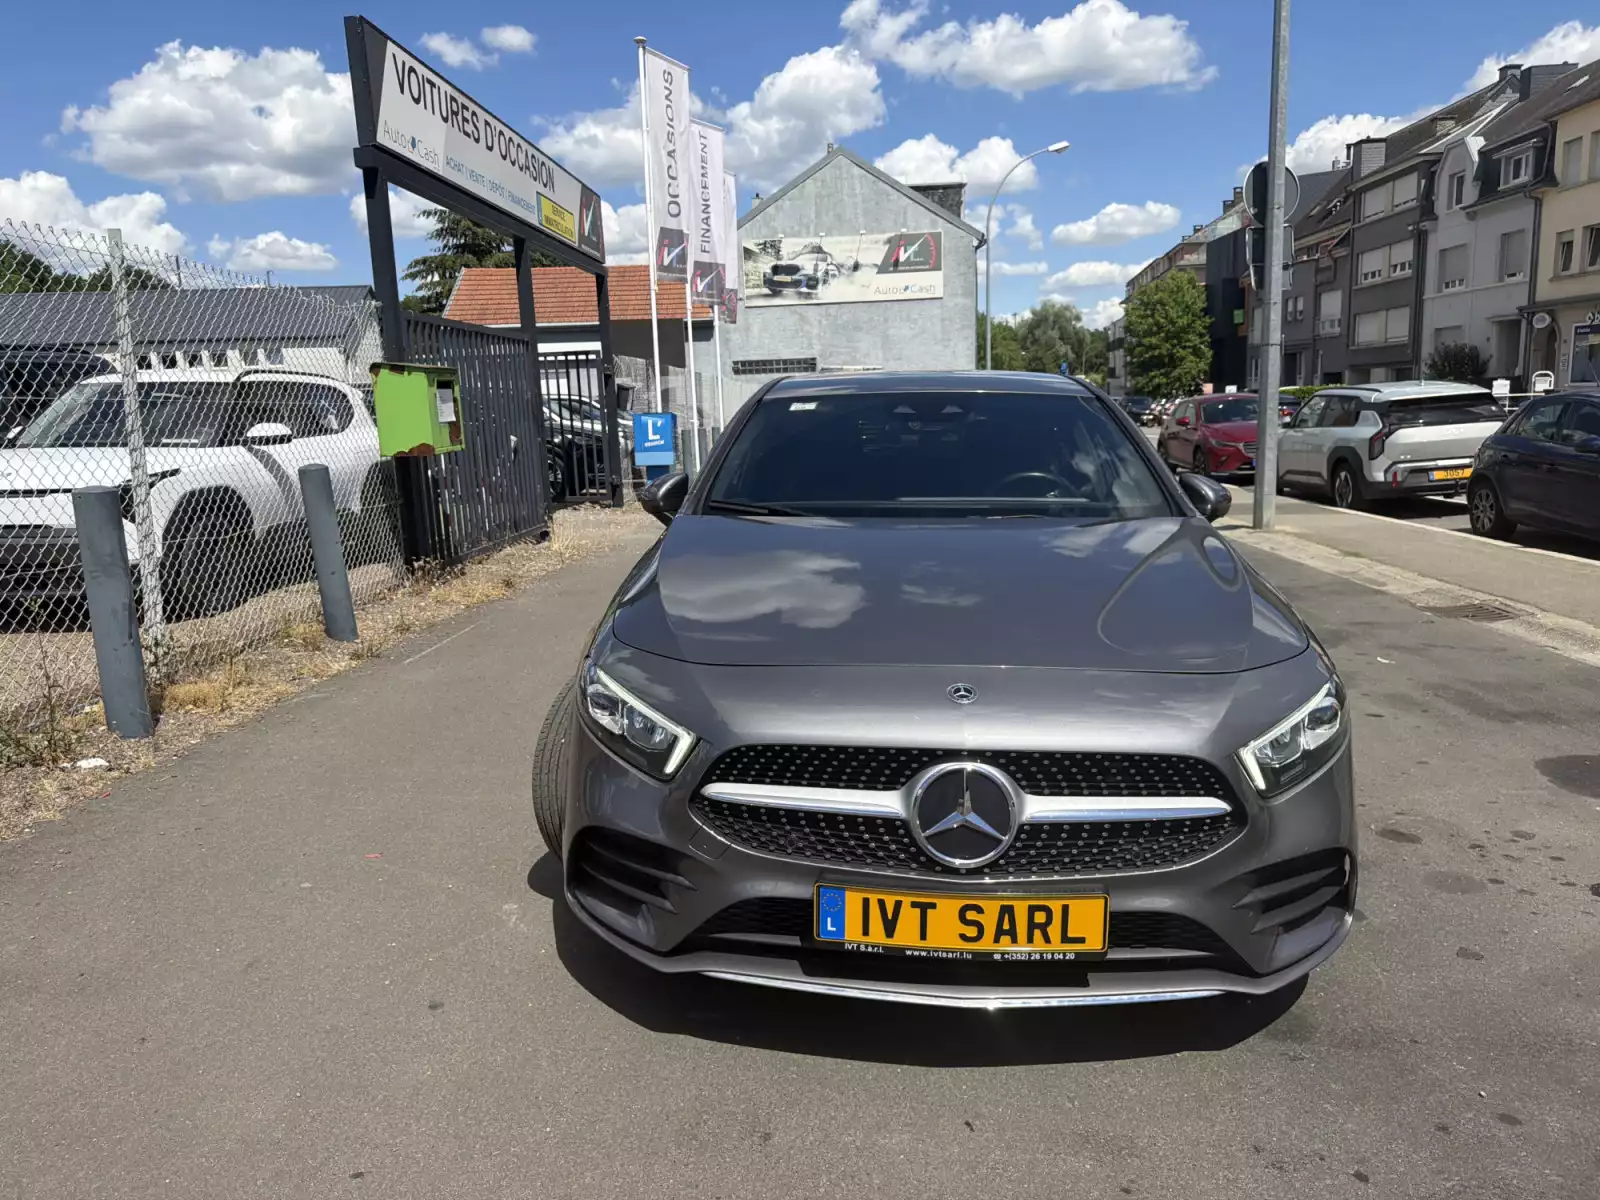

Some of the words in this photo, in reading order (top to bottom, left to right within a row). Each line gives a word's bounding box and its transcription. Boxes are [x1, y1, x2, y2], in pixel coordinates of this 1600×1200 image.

[392, 52, 480, 144] VOITURES
[484, 118, 555, 193] D'OCCASION
[662, 69, 682, 218] OCCASIONS
[699, 130, 712, 254] FINANCEMENT
[826, 917, 837, 932] L
[861, 897, 937, 942] IVT
[958, 904, 1086, 945] SARL
[844, 943, 858, 951] IVT
[905, 949, 972, 959] www.ivtsarl.lu
[1004, 952, 1029, 961] +(352)
[1031, 952, 1041, 960] 26
[1043, 952, 1052, 960] 19
[1065, 952, 1075, 960] 20
